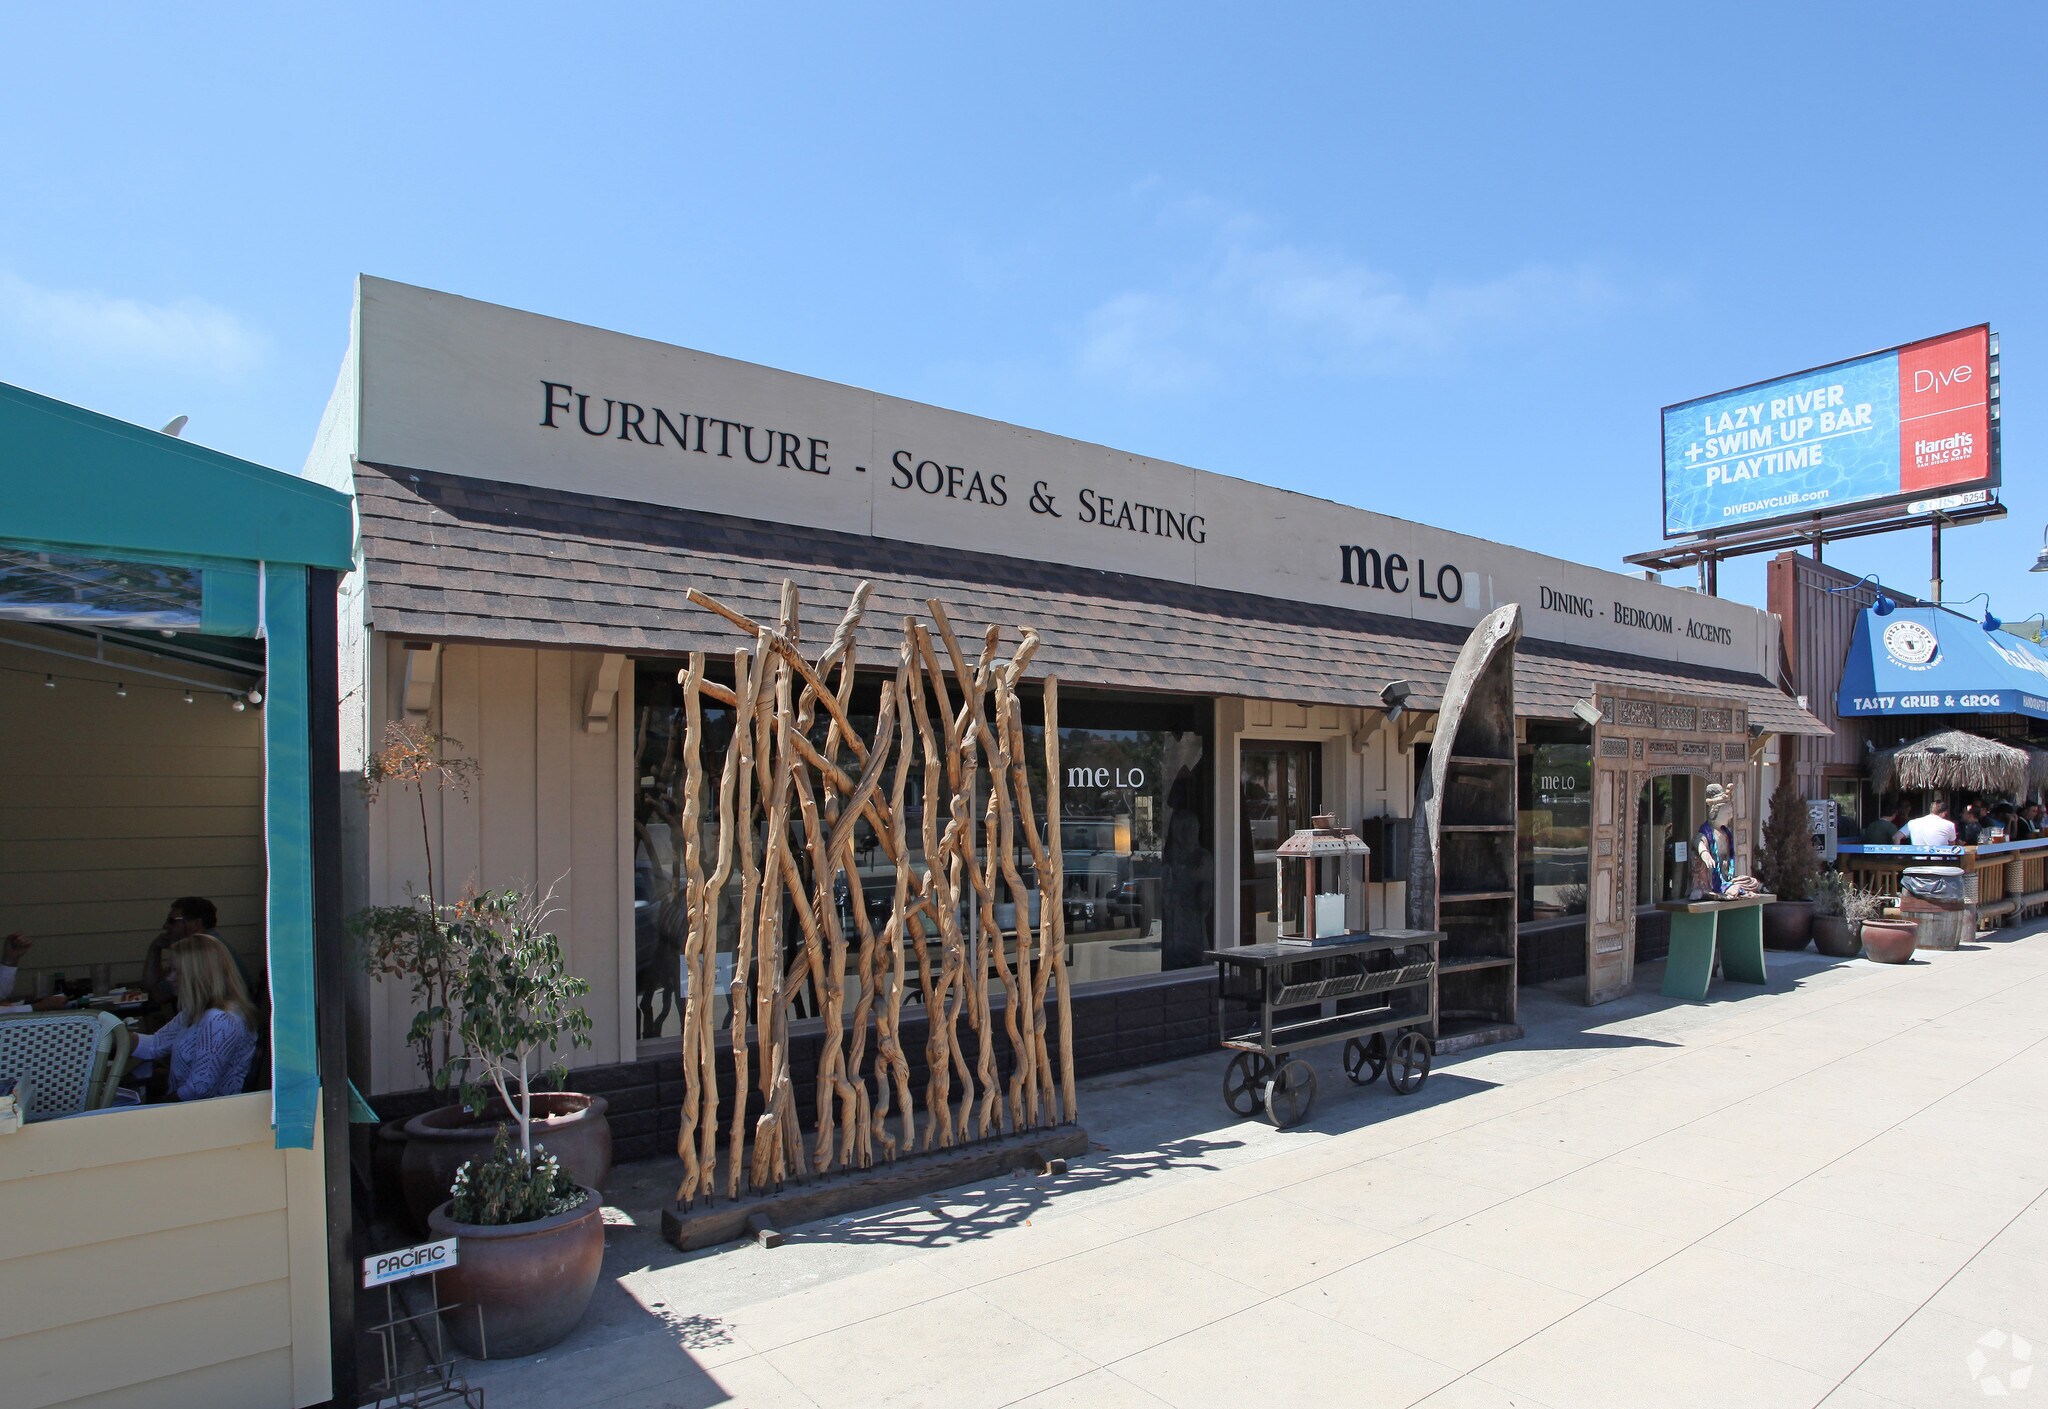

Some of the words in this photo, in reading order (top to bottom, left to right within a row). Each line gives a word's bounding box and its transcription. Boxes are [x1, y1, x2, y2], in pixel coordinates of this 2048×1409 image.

[1914, 365, 1972, 393] Dive
[1705, 402, 1764, 436] LAZY
[1771, 384, 1844, 420] RIVER
[1820, 403, 1872, 434] BAR
[539, 380, 831, 475] FURNITURE
[891, 450, 1008, 507] SOFAS
[1029, 481, 1062, 518] &
[1078, 488, 1206, 544] SEATING
[1706, 444, 1822, 487] PLAYTIME
[1916, 446, 1972, 464] RINCON
[1723, 489, 1829, 516] DIVEDAYCLUB.com
[1963, 491, 1985, 503] 6254
[1540, 585, 1594, 618] DINING
[1614, 601, 1673, 634] BEDROOM
[1686, 618, 1732, 645] ACCENTS
[1887, 624, 1905, 640] PIZZA
[1910, 625, 1929, 639] PORT
[1887, 655, 1906, 668] TASTY
[1853, 697, 1895, 710] TASTY
[1900, 695, 1939, 708] GRUB
[1945, 695, 1955, 707] &
[1960, 694, 2000, 707] GROG
[376, 1245, 445, 1275] PACIFIC
